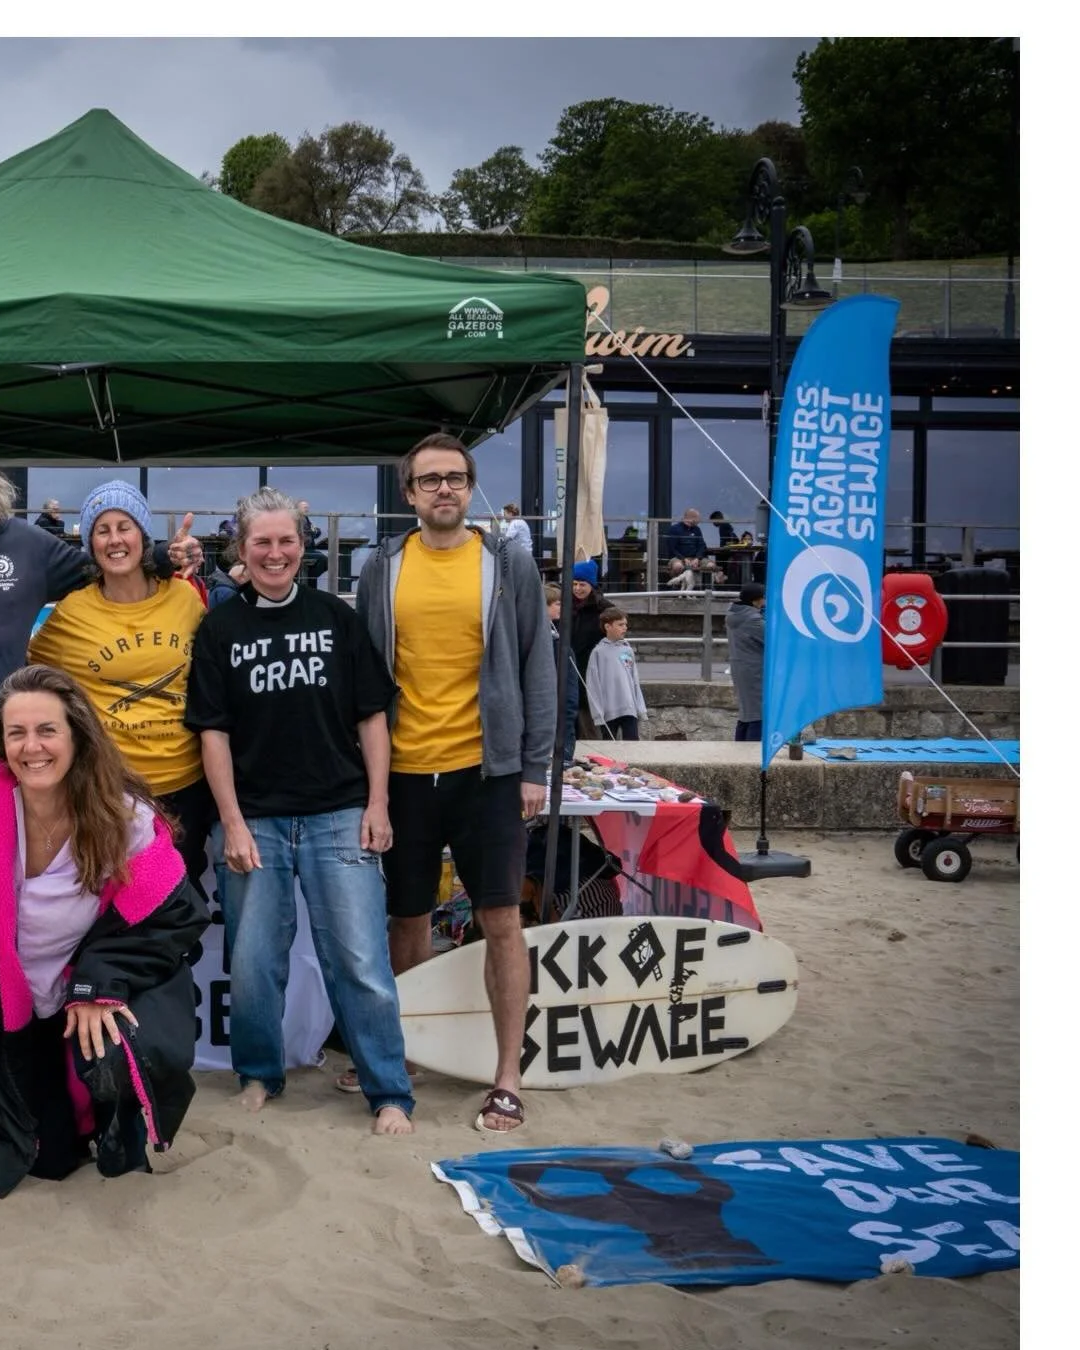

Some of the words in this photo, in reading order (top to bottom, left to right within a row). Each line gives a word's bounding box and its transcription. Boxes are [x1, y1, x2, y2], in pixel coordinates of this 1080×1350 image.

[448, 321, 503, 331] GAZEBOS
[786, 386, 820, 537] SURFERS
[812, 387, 850, 539] AGAINST
[847, 392, 883, 541] SEWAGE
[88, 631, 194, 673] SURFERS
[230, 638, 272, 667] CUT
[284, 629, 333, 653] THE
[250, 656, 324, 693] CRAP
[619, 922, 707, 988] OF
[822, 1178, 1020, 1213] OUR
